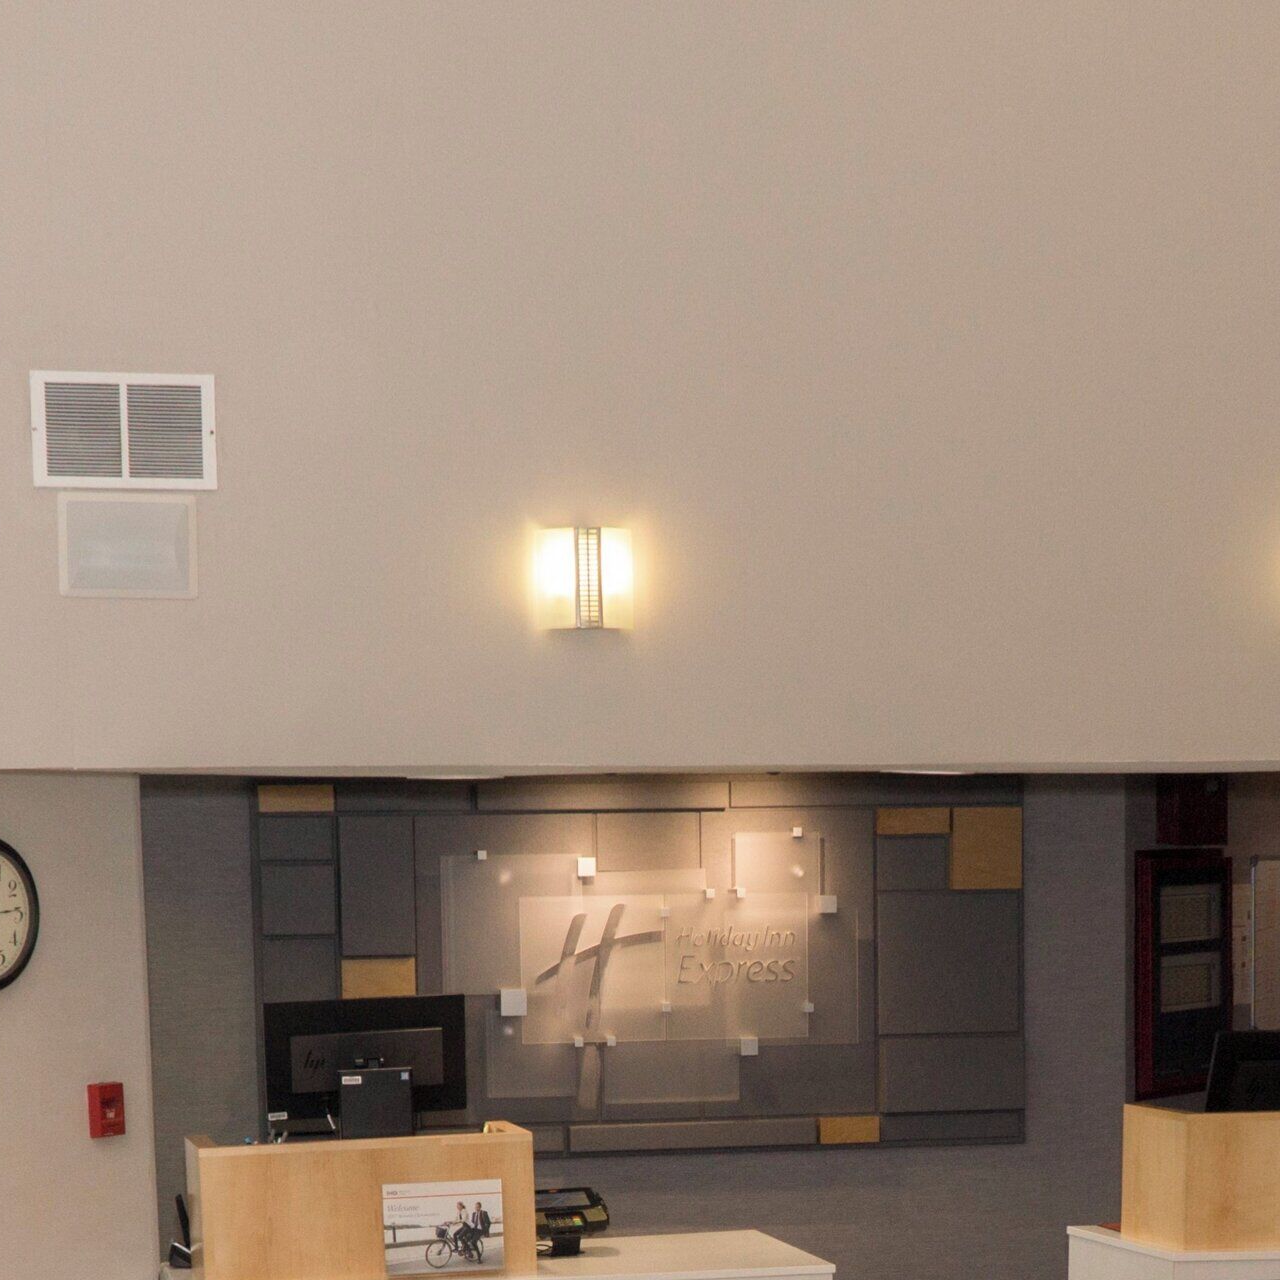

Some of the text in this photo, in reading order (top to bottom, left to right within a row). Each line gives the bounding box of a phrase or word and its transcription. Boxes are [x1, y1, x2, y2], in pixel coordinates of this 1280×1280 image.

[8, 880, 17, 898] 2
[8, 930, 17, 946] 4
[675, 925, 798, 952] Holiday Inn
[677, 955, 798, 984] Express
